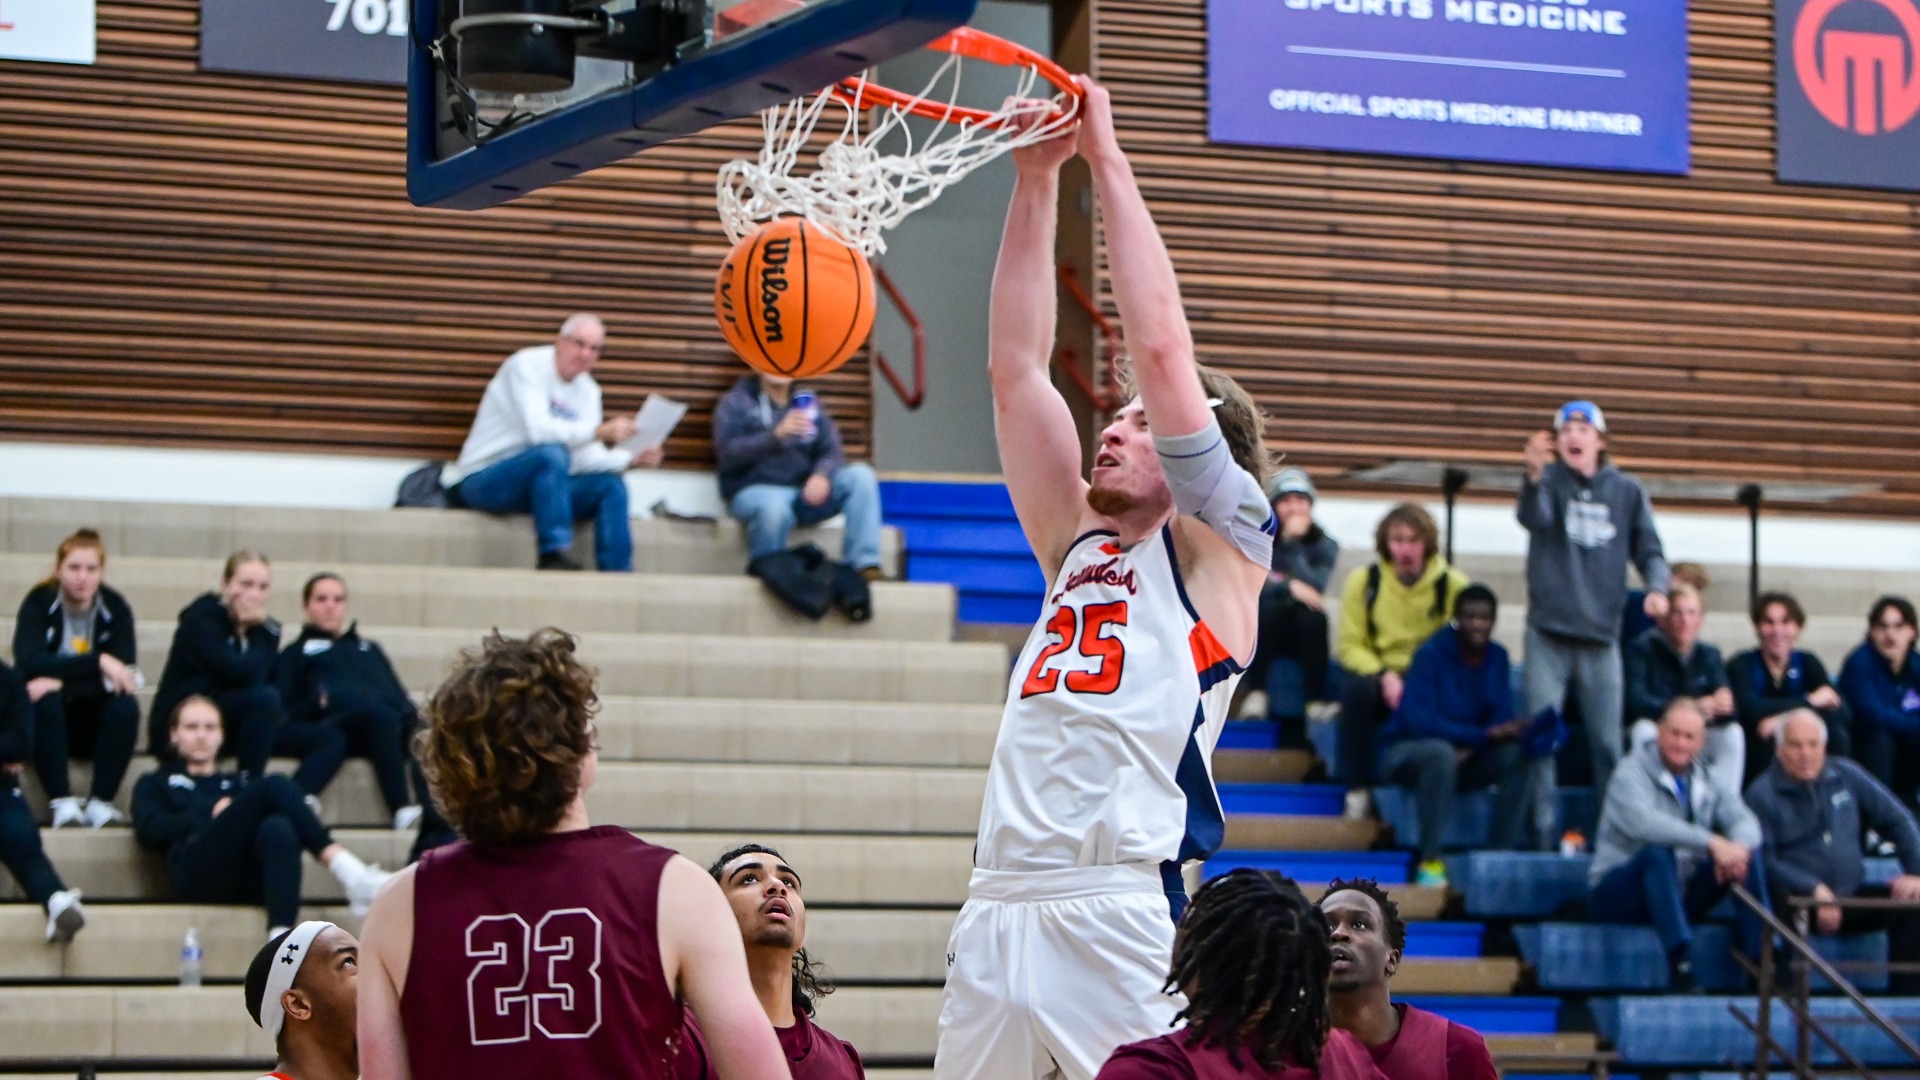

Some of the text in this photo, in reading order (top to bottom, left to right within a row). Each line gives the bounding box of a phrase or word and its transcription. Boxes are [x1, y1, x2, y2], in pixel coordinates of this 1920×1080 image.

[324, 0, 409, 36] 701
[1444, 1, 1628, 36] MEDICINE
[1268, 88, 1644, 136] OFFICIAL SPORTS MEDICINE PARTNER
[761, 236, 791, 344] Wilson
[1020, 599, 1128, 700] 25
[465, 907, 603, 1046] 23
